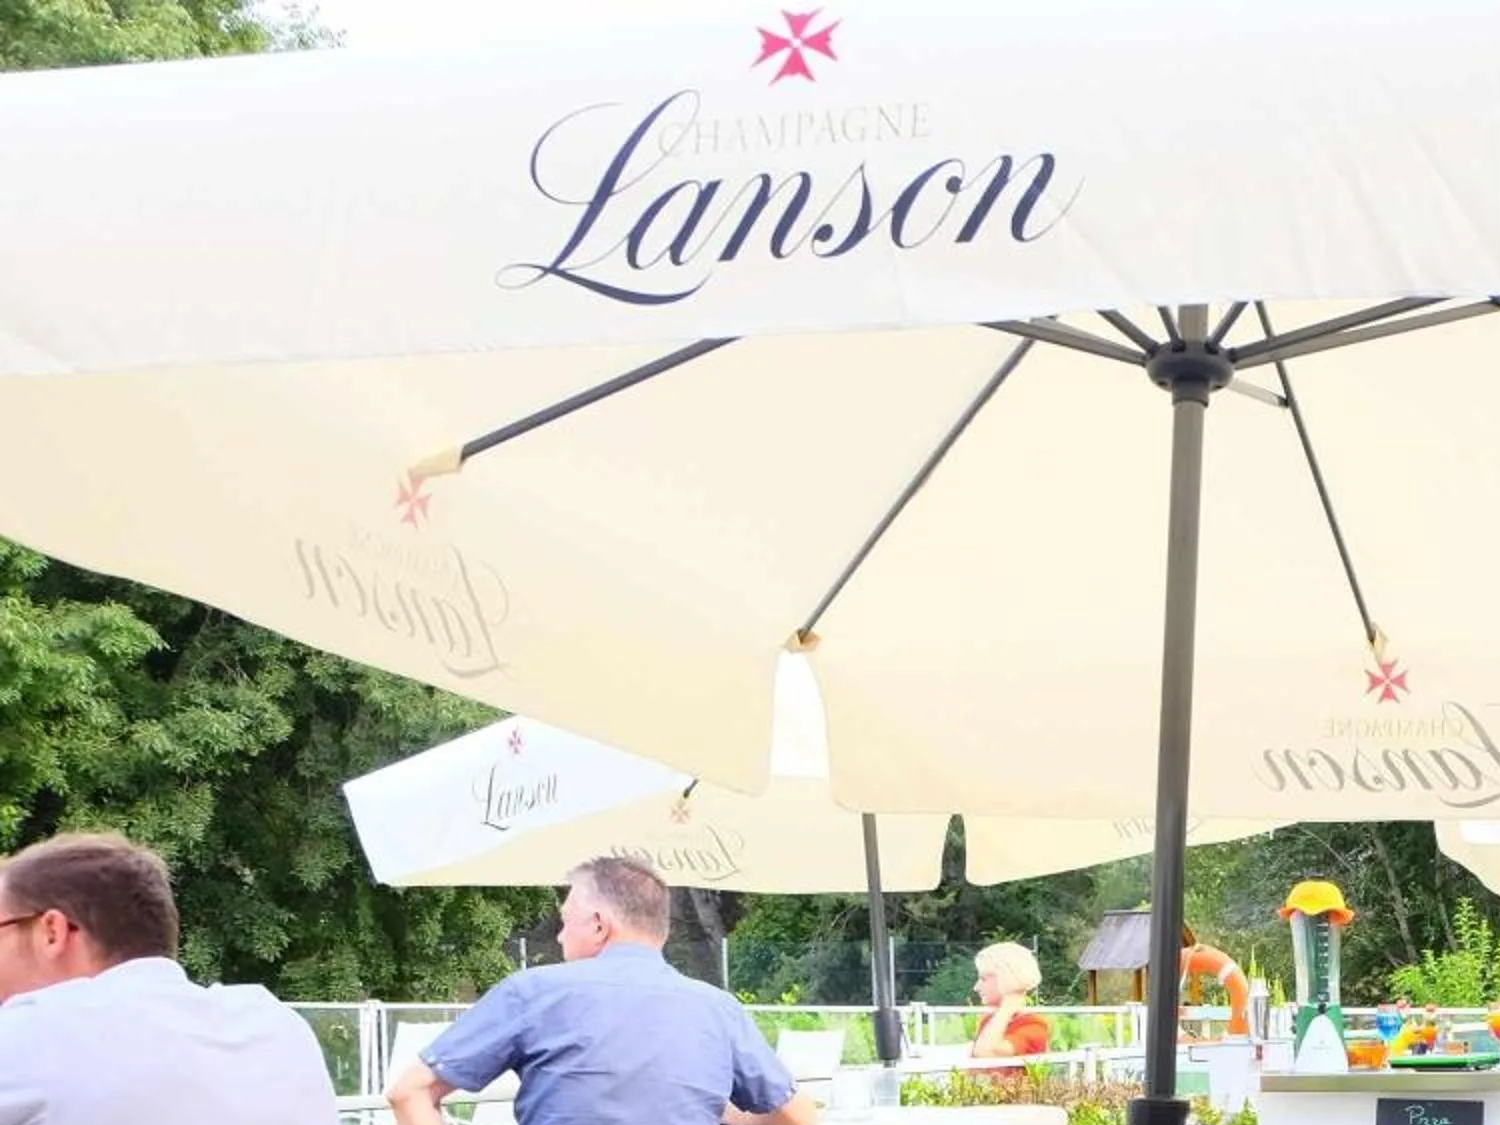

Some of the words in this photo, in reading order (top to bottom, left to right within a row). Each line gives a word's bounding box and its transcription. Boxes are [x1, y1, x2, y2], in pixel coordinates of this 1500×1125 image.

[657, 102, 932, 159] CHAMPAGNE
[494, 88, 1087, 306] Lanson
[471, 763, 558, 831] Lanson
